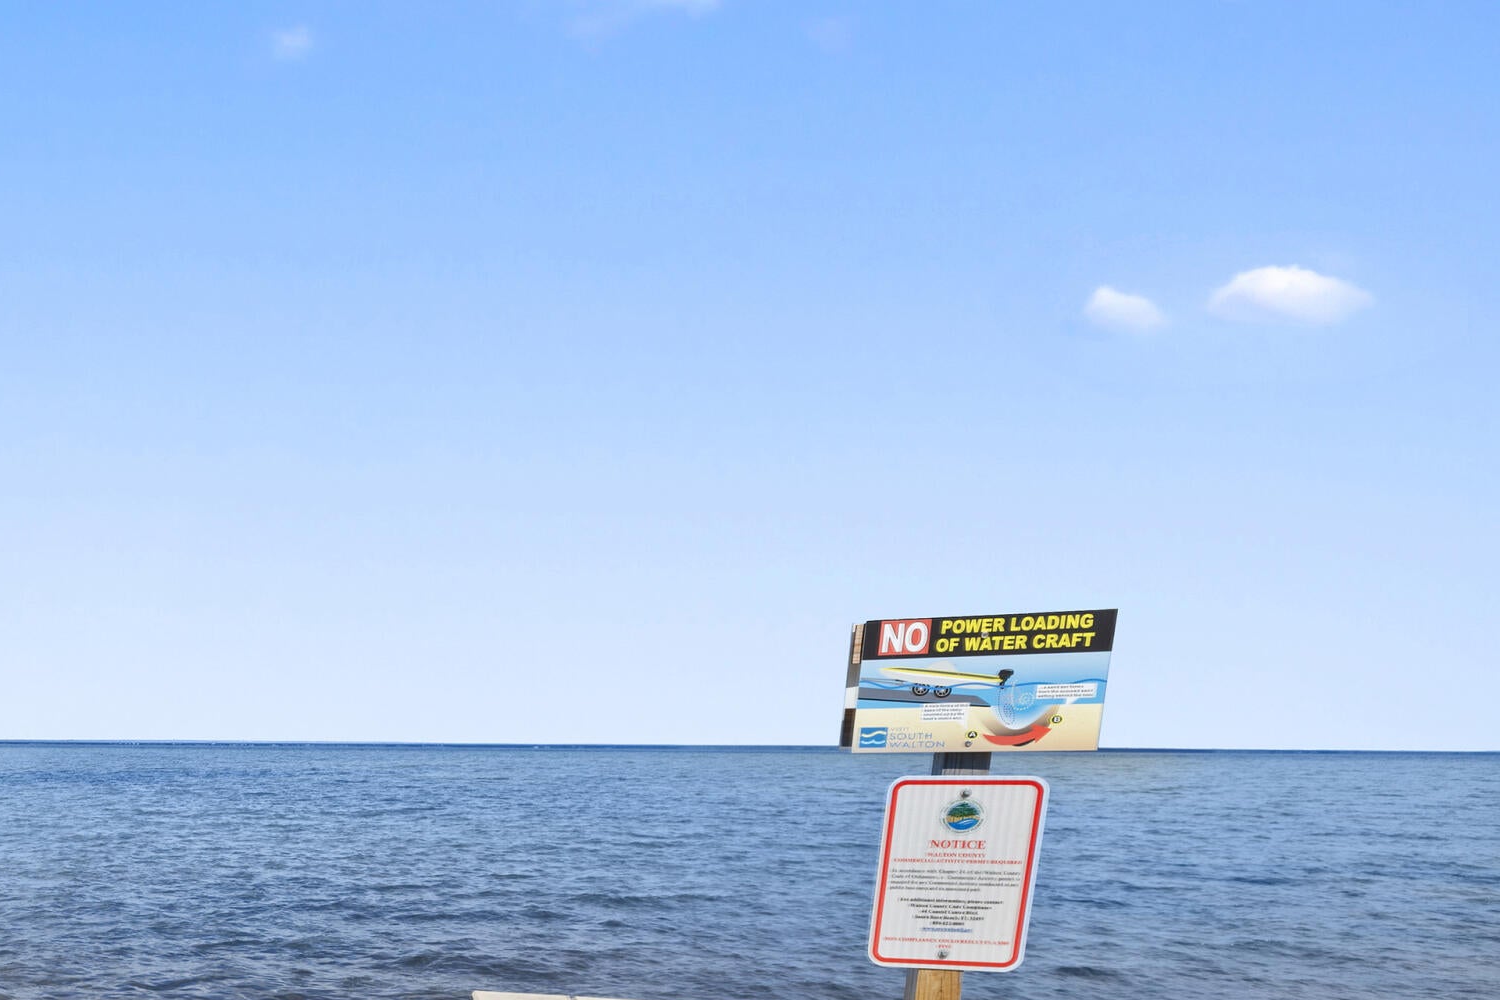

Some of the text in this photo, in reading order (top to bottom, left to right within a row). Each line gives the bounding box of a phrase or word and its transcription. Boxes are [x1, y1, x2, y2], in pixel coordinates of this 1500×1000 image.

[940, 613, 1095, 635] POWER LOADING
[881, 621, 929, 654] NO
[935, 631, 1096, 653] OF WATER CRAFT
[889, 732, 933, 740] SOUTH
[889, 741, 945, 749] WALTON
[929, 839, 987, 850] NOTICE
